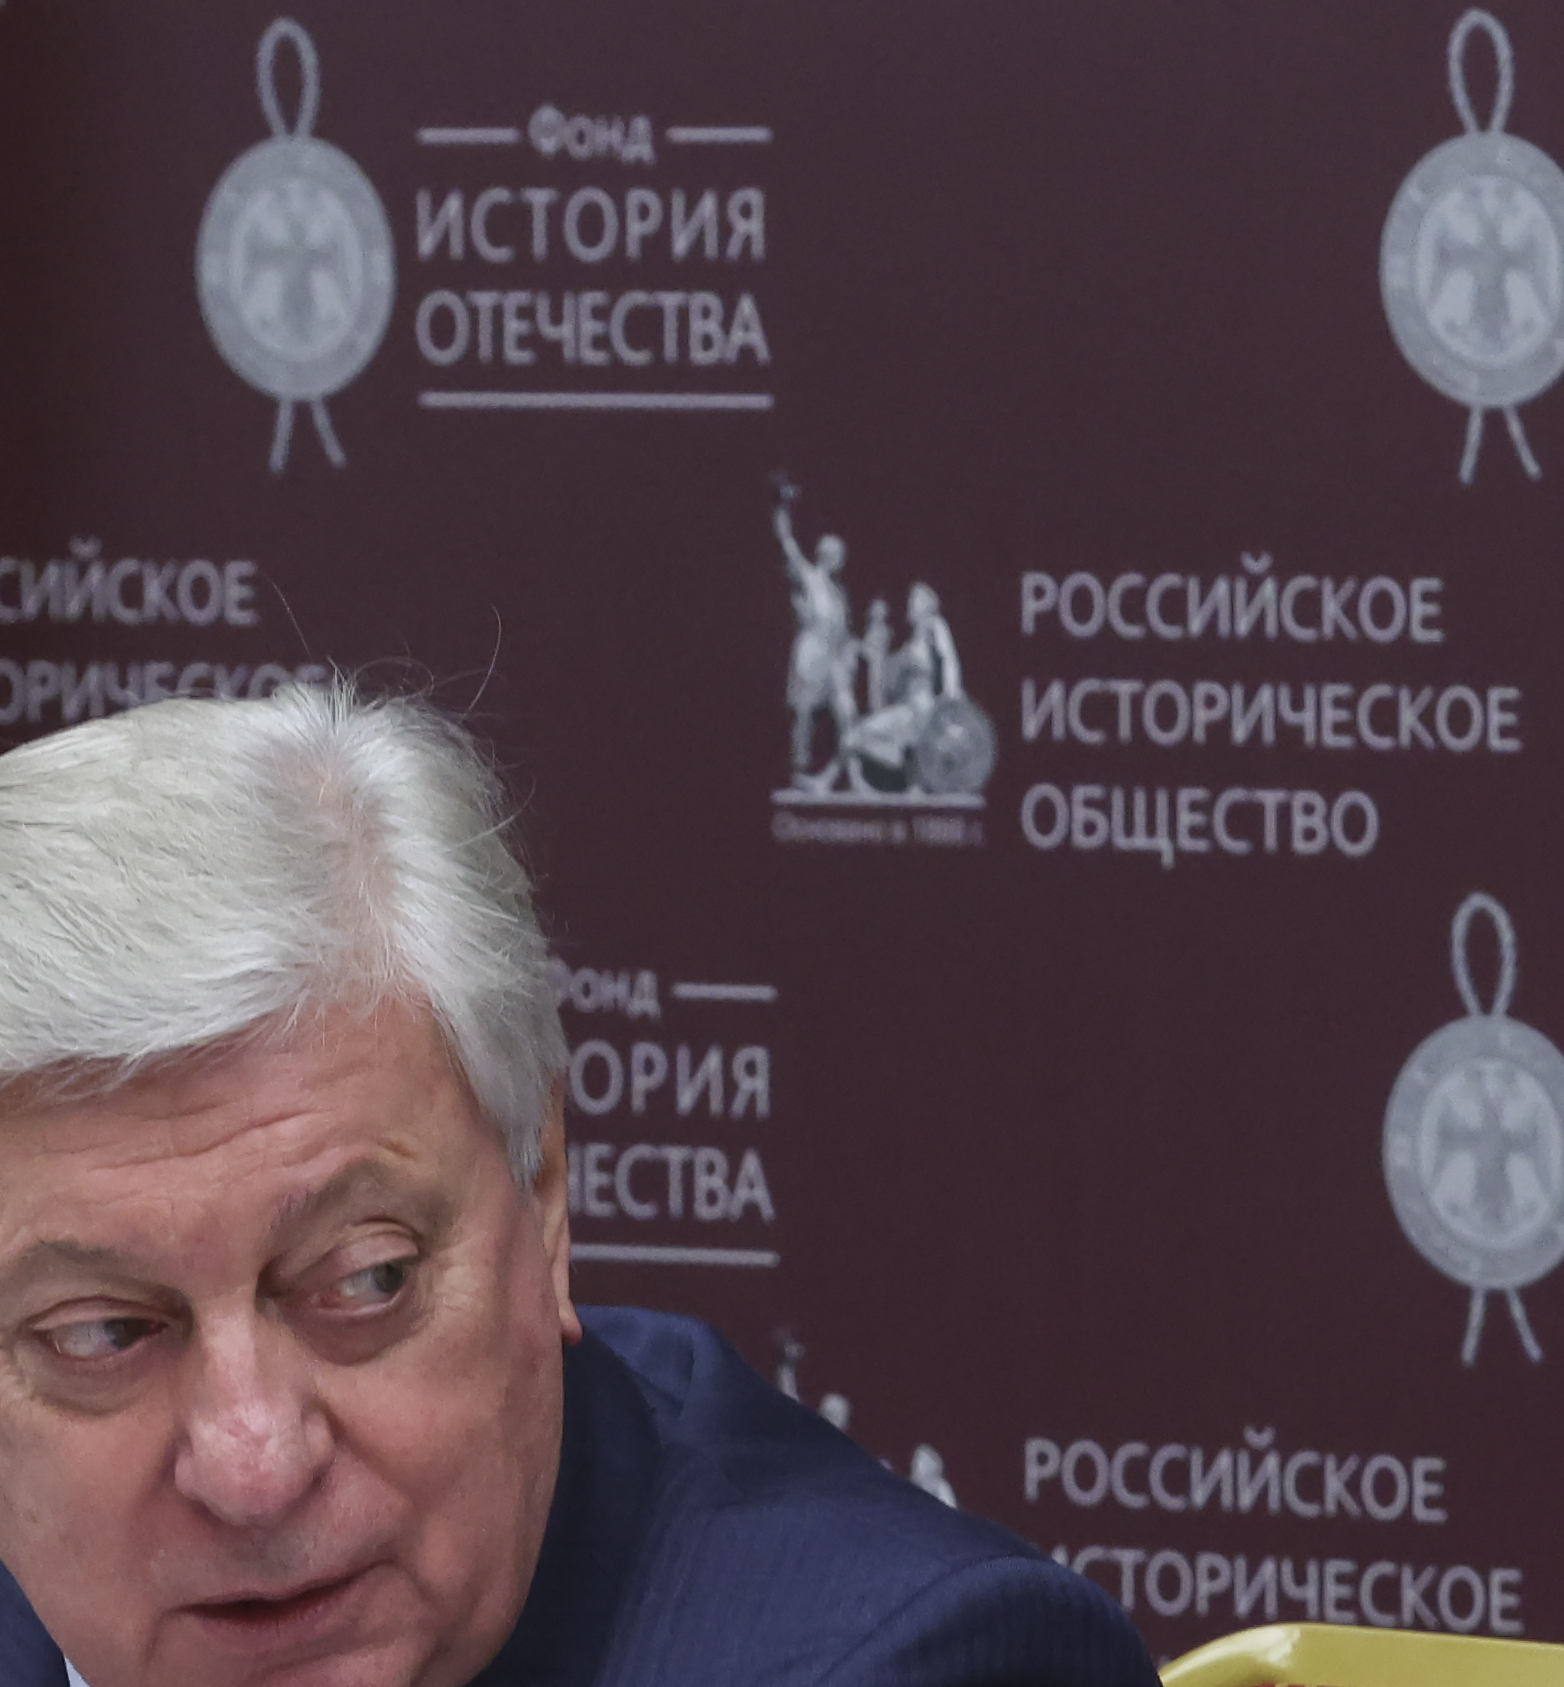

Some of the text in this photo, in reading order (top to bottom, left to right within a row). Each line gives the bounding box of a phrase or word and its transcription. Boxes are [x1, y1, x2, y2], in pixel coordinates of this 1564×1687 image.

[527, 104, 657, 165] Фонд
[415, 187, 767, 263] ИСТОРИЯ
[414, 289, 771, 366] ОТЕЧЕСТВА
[1020, 551, 1445, 643] РОССИЙСКОЕ
[1021, 677, 1523, 752] ИСТОРИЧЕСКОЕ
[1020, 782, 1380, 869] ОБЩЕСТВО
[568, 1039, 771, 1117] ОРИЯ
[568, 1143, 776, 1222] ЕСТВА
[1024, 1425, 1448, 1523] РОССИЙСКОЕ
[1049, 1544, 1525, 1636] СТОРИЧЕСКОЕ
